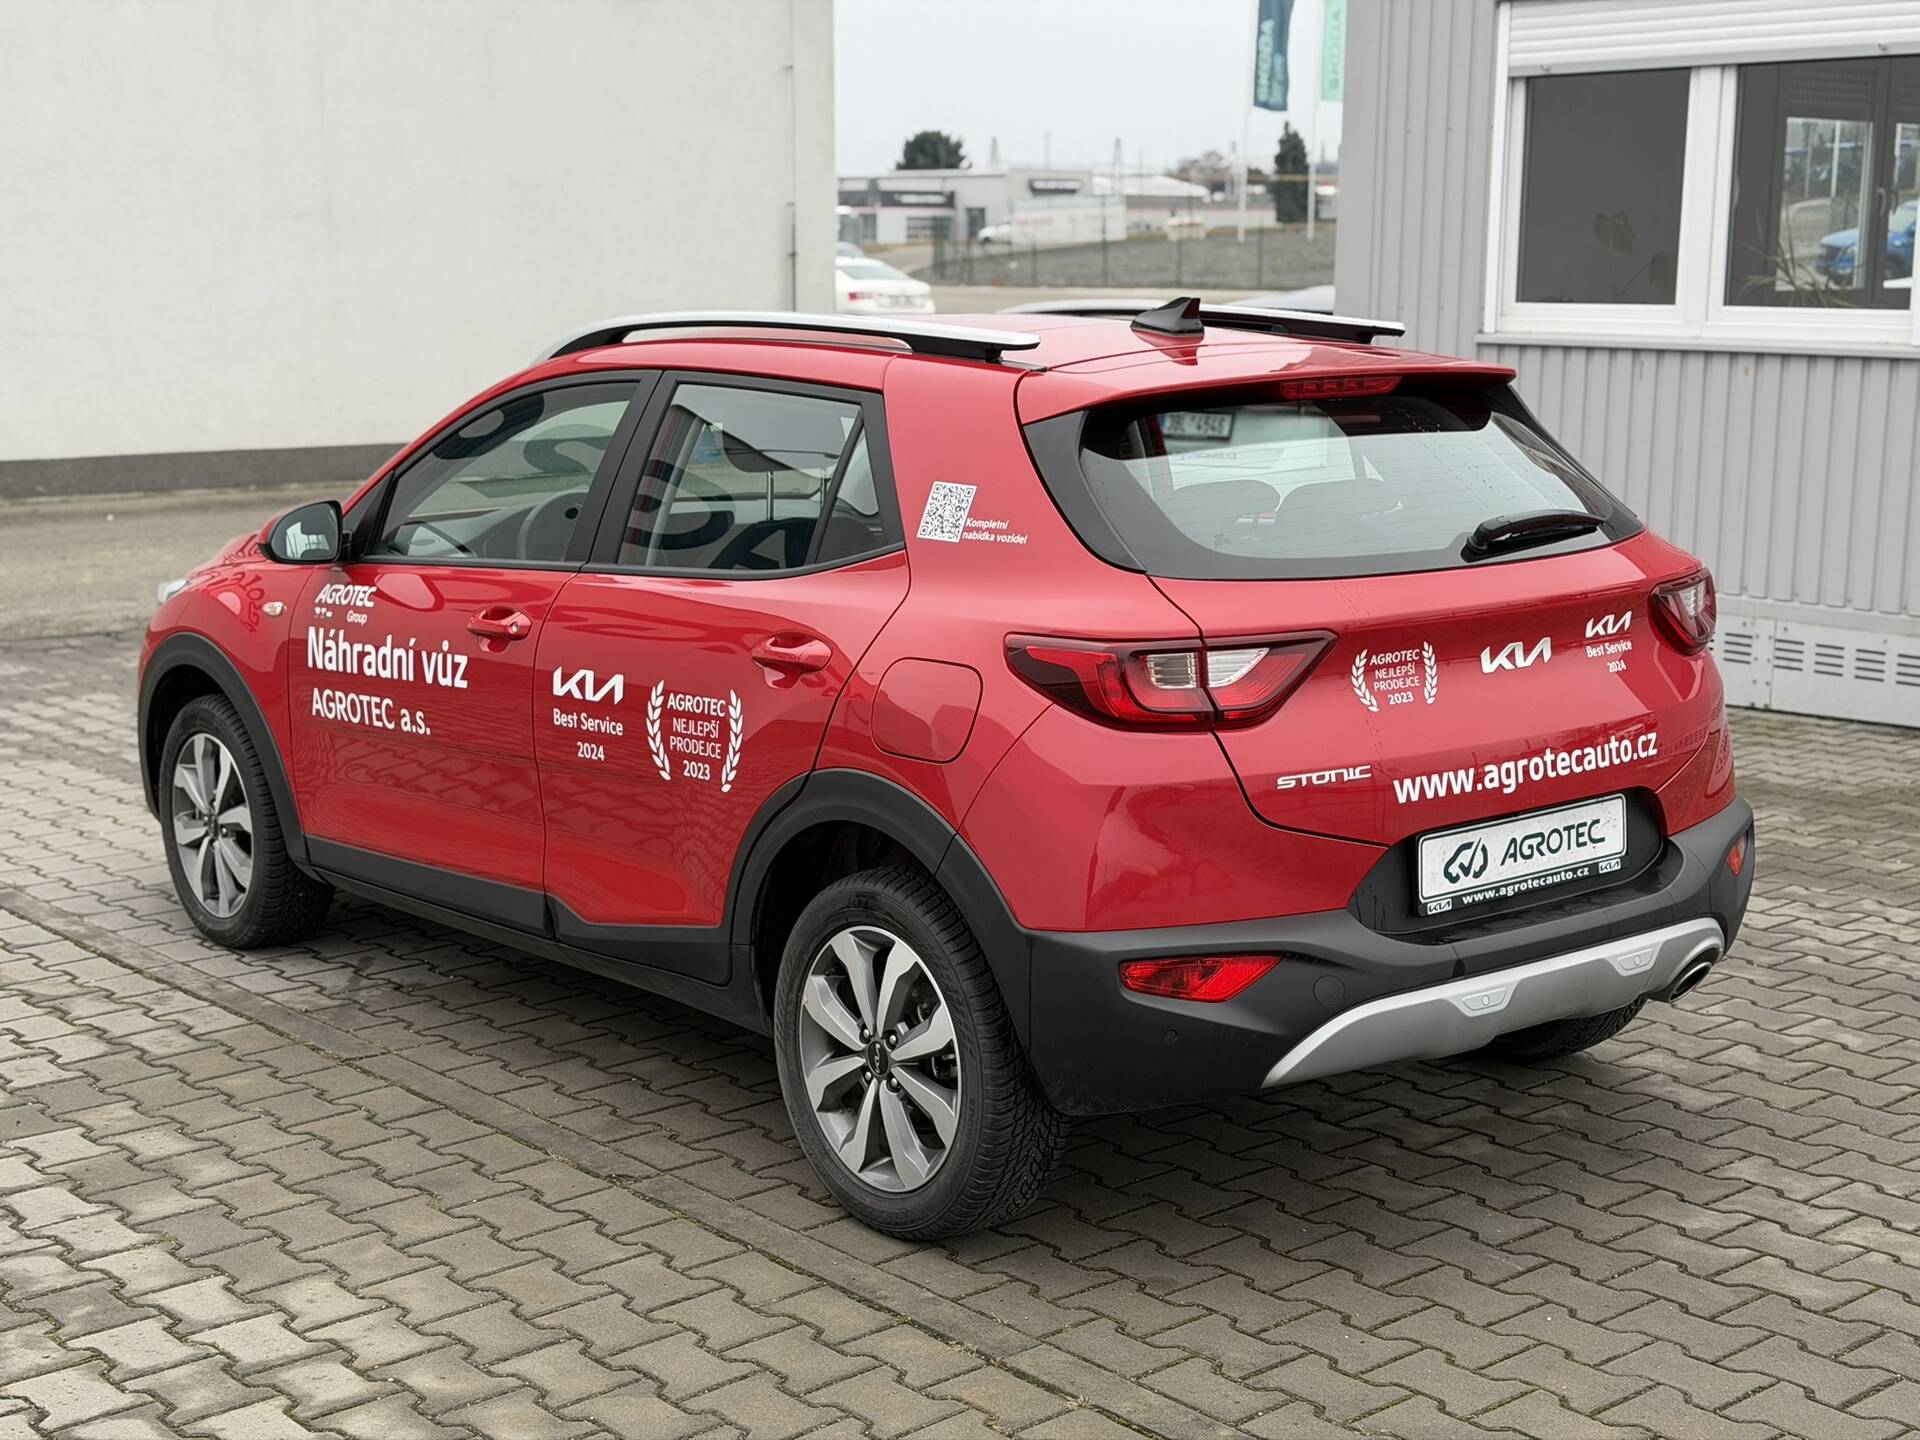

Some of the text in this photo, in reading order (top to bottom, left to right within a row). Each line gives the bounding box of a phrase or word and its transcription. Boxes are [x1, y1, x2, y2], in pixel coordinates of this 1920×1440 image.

[966, 517, 1009, 530] Kompletní
[996, 533, 1028, 545] vozidel
[315, 584, 377, 607] AGROTEC
[347, 610, 368, 626] Group
[1586, 611, 1632, 638] KIA
[308, 626, 468, 688] Náhradní vůz
[1369, 649, 1420, 665] AGROTEC
[1480, 637, 1552, 674] KIA
[1586, 640, 1632, 658] Best Service
[1374, 662, 1416, 680] NEJLEPŠÍ
[1607, 661, 1627, 673] 2024
[552, 666, 624, 705] KIA
[1373, 676, 1421, 692] PRODEJCE
[667, 692, 726, 718] AGROTEC
[1387, 691, 1414, 705] 2023
[312, 688, 431, 735] AGROTEC a.s.
[553, 708, 623, 736] Best Service
[672, 717, 720, 738] NEJLEPŠÍ
[577, 742, 605, 761] 2024
[669, 736, 722, 760] PRODEJCE
[683, 760, 711, 780] 2023
[1276, 764, 1372, 790] STONIC
[1393, 732, 1657, 803] www.agrotecauto.cz
[1500, 818, 1606, 866] AGROTEC
[1428, 900, 1451, 914] KIA
[1461, 867, 1590, 905] www.agrotecauto.cz
